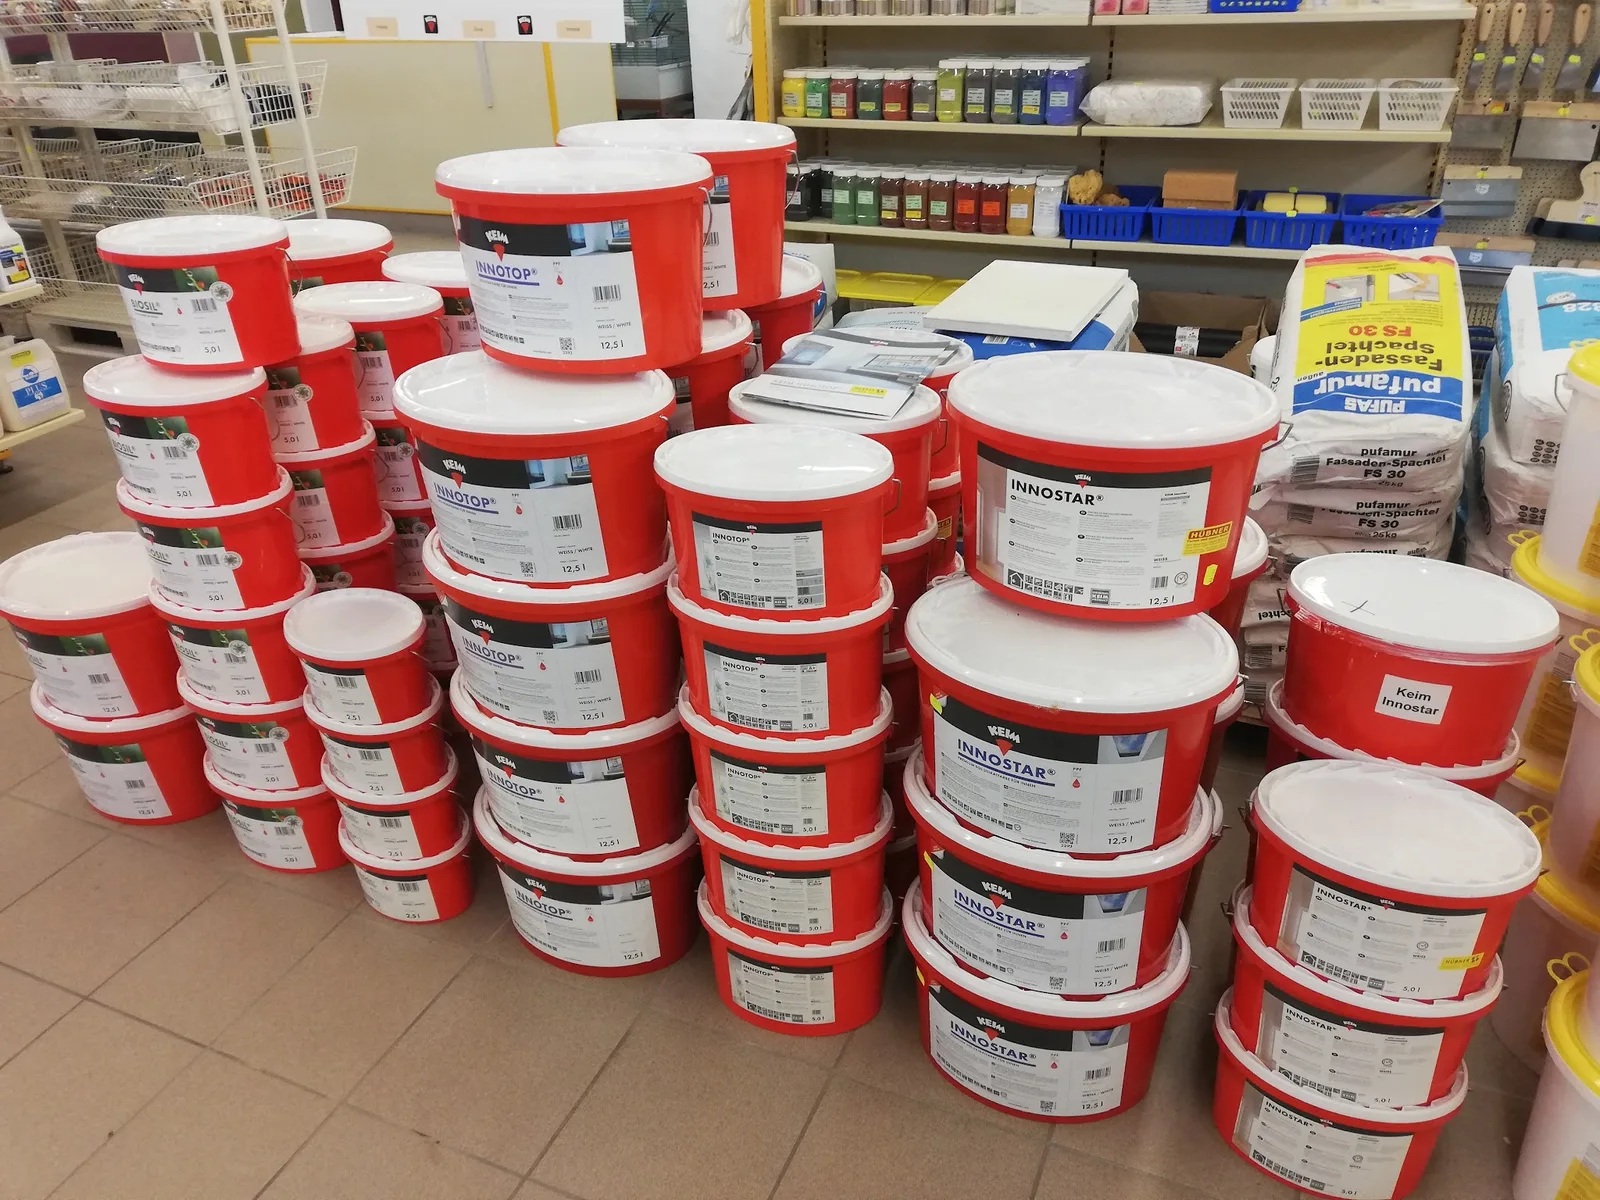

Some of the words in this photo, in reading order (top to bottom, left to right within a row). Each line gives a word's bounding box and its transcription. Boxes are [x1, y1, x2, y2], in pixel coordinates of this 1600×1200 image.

[484, 228, 509, 244] KEIM
[476, 260, 538, 280] INNOTOP®
[703, 280, 715, 289] 2,5
[1349, 325, 1378, 336] 30
[1383, 325, 1411, 337] FS
[204, 346, 217, 354] 5,0
[600, 342, 618, 350] 12,5
[1326, 340, 1435, 354] Spachtel
[1315, 354, 1442, 371] Fassaden-
[24, 381, 48, 396] PLUS
[1313, 373, 1441, 394] pufamur
[1361, 447, 1417, 458] pufamur
[442, 458, 466, 474] KEIM
[1326, 454, 1446, 468] Fassaden-Spachtel
[1074, 474, 1092, 482] KEIM
[1364, 469, 1382, 478] FS
[1387, 469, 1406, 478] 30
[176, 490, 188, 498] 5,0
[434, 482, 496, 508] INNOTOP®
[1011, 478, 1104, 506] INNOSTAR®
[1356, 500, 1411, 510] pufamur
[1358, 519, 1377, 528] FS
[1380, 520, 1399, 528] 30
[712, 532, 750, 544] INNOTOP®
[1190, 525, 1229, 539] HÜBNER
[562, 564, 580, 573] 12,5
[209, 594, 219, 602] 5,0
[1149, 597, 1168, 606] 12,5
[471, 618, 494, 633] KEIM
[462, 636, 522, 664] INNOTOP®
[722, 661, 758, 672] INNOTOP®
[1396, 686, 1432, 701] Keim
[1382, 697, 1439, 715] Innostar
[582, 712, 600, 721] 12,5
[987, 725, 1021, 744] KEIM
[495, 754, 516, 769] KEIM
[958, 738, 1056, 780] INNOSTAR®
[727, 767, 760, 779] INNOTOP®
[486, 768, 542, 796] INNOTOP®
[599, 840, 615, 848] 12,5
[1108, 836, 1128, 846] 12,5
[736, 871, 768, 883] INNOTOP®
[525, 878, 547, 892] KEIM
[981, 881, 1012, 900] KEIM
[515, 888, 572, 916] INNOTOP®
[1317, 887, 1372, 912] INNOSTAR®
[954, 888, 1046, 932] INNOSTAR®
[624, 953, 638, 961] 12,5
[1094, 979, 1112, 988] 12,5
[1402, 985, 1416, 993] 5,0
[976, 1015, 1006, 1034] KEIM
[1286, 1008, 1336, 1032] INNOSTAR®
[950, 1020, 1036, 1062] INNOSTAR®
[1082, 1102, 1099, 1110] 12,5
[1266, 1101, 1313, 1127] INNOSTAR®
